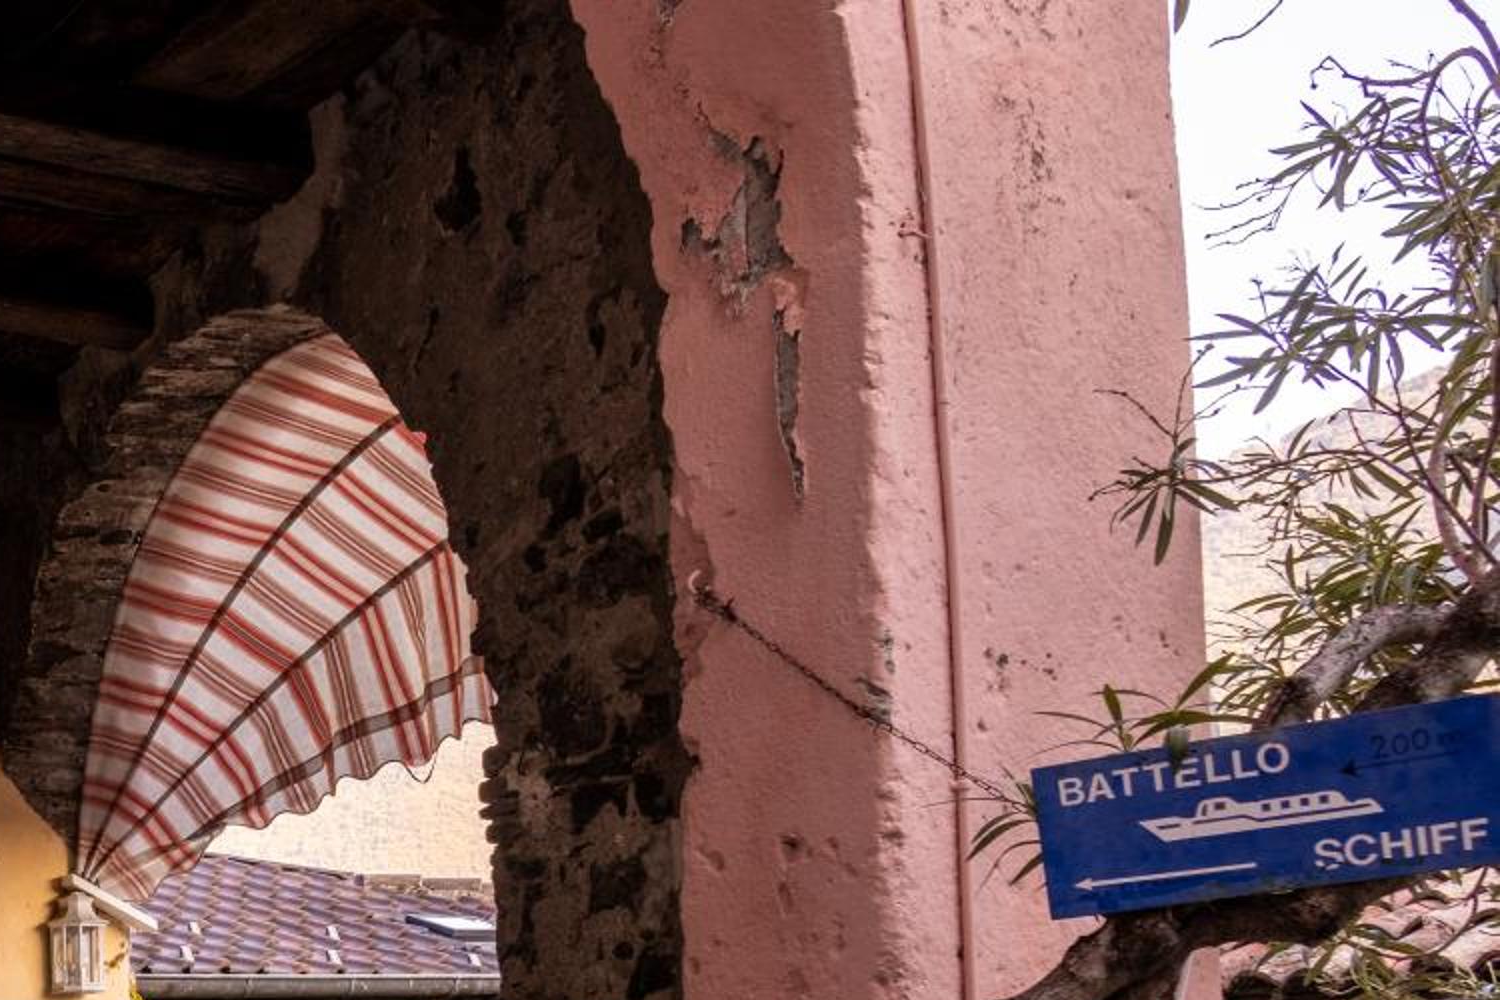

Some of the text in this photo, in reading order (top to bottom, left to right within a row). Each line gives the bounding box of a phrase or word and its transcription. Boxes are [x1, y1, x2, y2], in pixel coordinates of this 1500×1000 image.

[1368, 727, 1430, 760] 200
[1056, 741, 1291, 808] BATTELLO
[1313, 816, 1490, 872] SCHIFF
